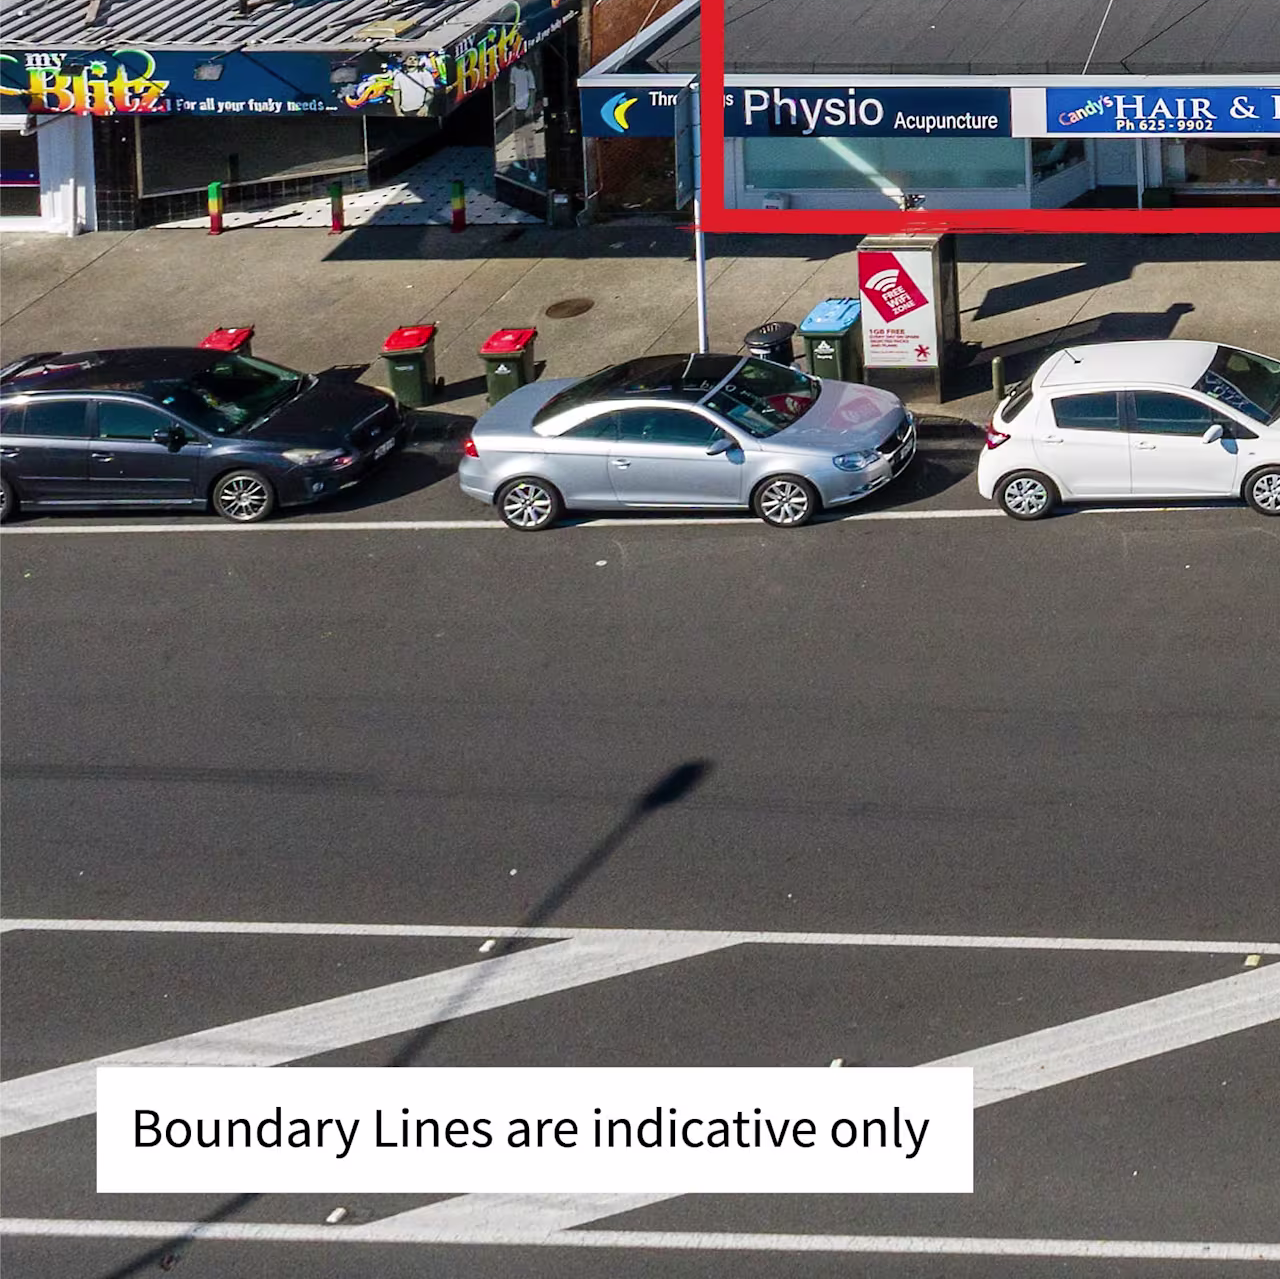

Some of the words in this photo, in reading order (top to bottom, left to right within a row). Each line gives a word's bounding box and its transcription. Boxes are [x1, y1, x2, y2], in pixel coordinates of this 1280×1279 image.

[24, 52, 67, 71] my
[176, 99, 198, 112] For
[199, 98, 216, 112] all
[218, 100, 245, 114] your
[248, 98, 283, 114] funky
[648, 91, 679, 107] Thr
[744, 87, 884, 135] Physio
[893, 111, 998, 133] Acupuncture
[1058, 94, 1115, 127] Candy's
[1114, 95, 1217, 120] HAIR
[1229, 96, 1260, 119] &
[1116, 119, 1136, 131] Ph
[1138, 119, 1166, 132] 625
[1176, 119, 1214, 132] 9902
[881, 285, 906, 301] FREE
[892, 299, 917, 315] ZONE
